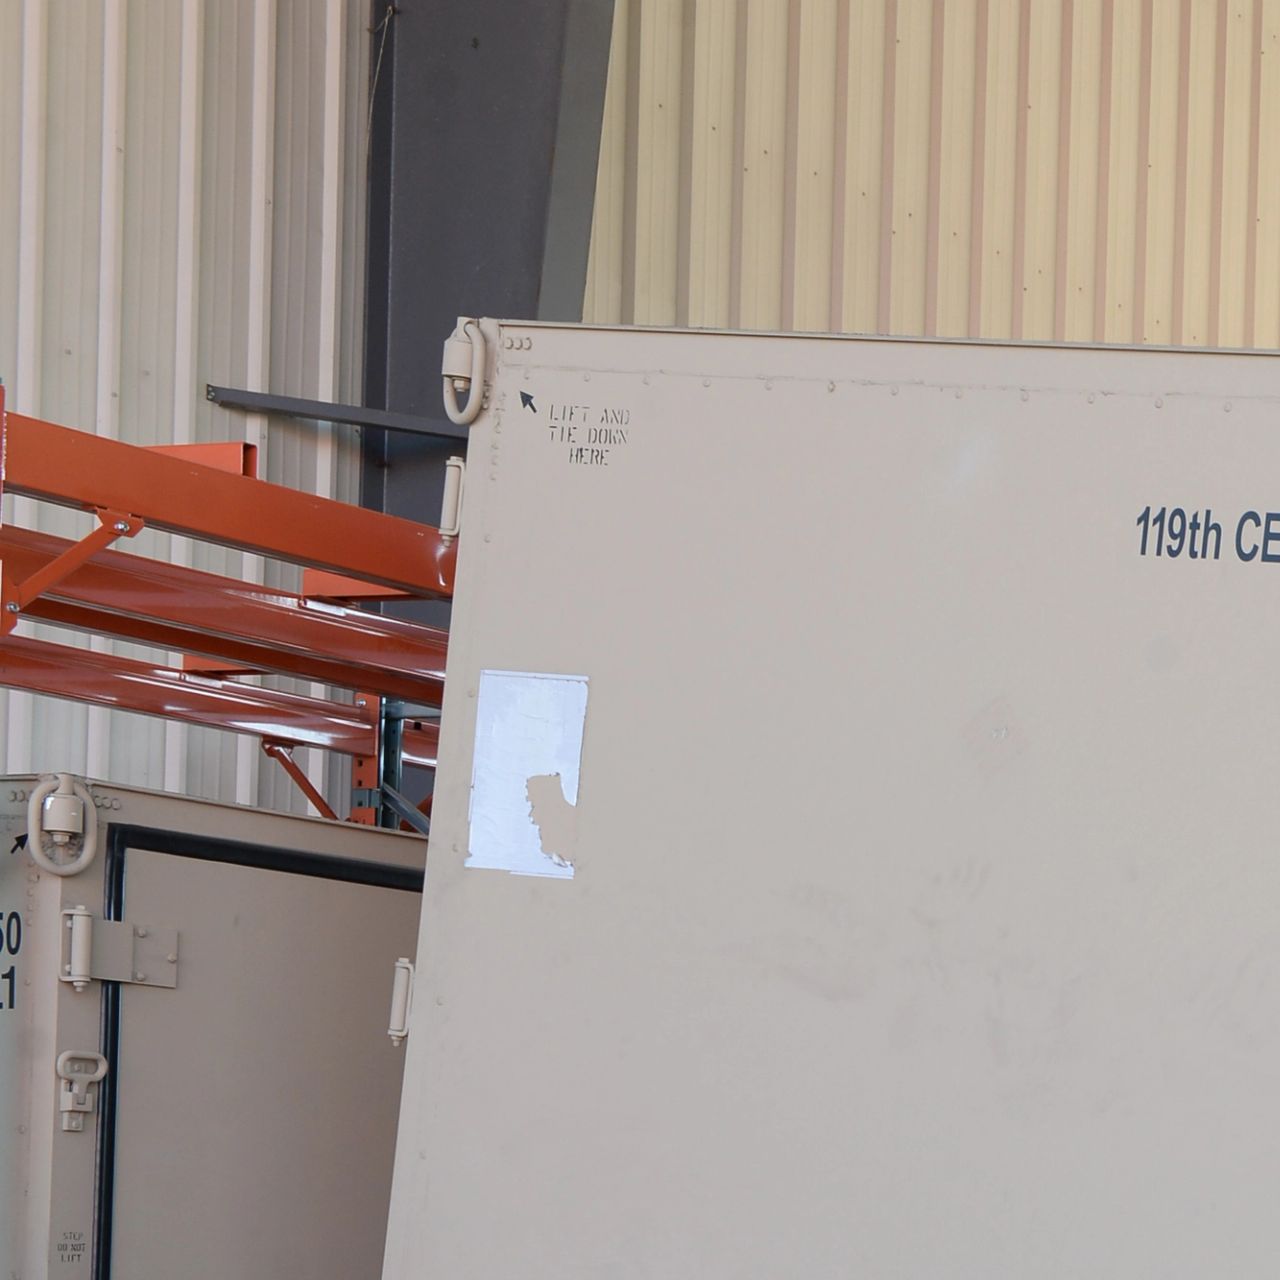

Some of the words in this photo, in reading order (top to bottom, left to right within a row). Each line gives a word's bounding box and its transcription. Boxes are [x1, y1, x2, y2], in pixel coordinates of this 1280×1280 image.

[549, 404, 590, 423] LIFT
[600, 408, 630, 425] AND
[549, 425, 578, 443] TIE
[587, 427, 627, 444] DOWN
[569, 447, 610, 466] HERE
[1136, 505, 1222, 560] 119th
